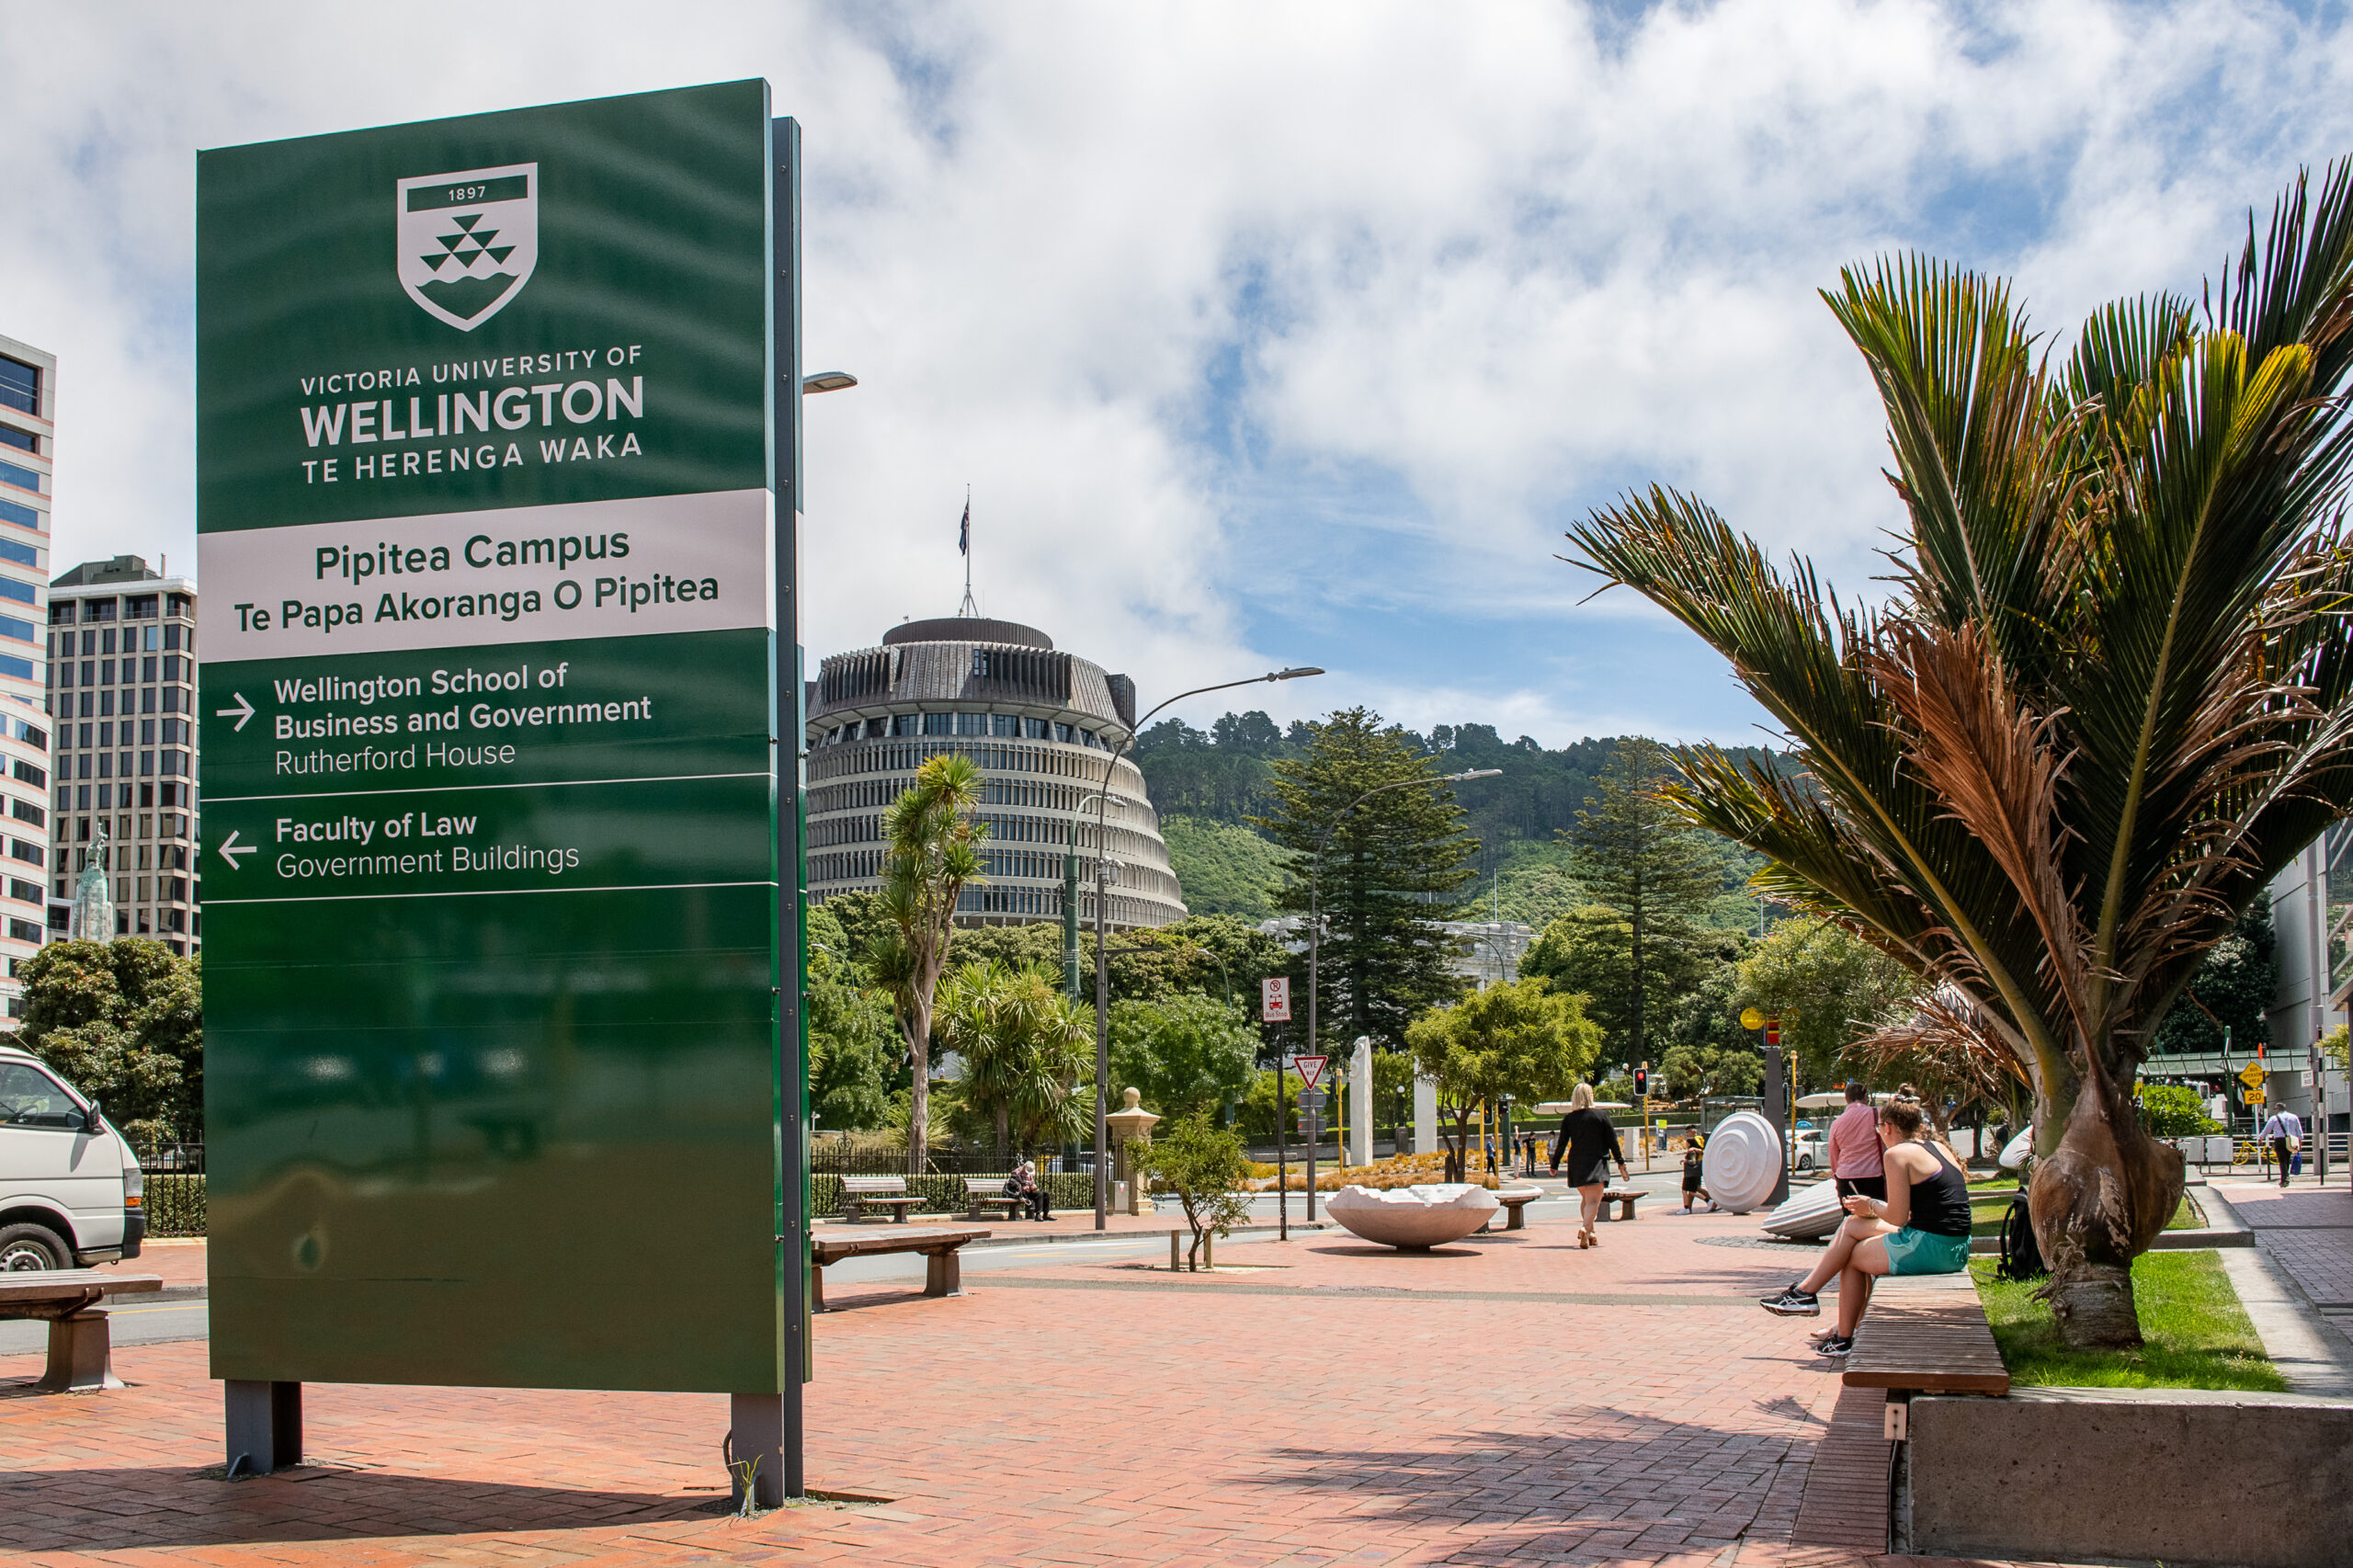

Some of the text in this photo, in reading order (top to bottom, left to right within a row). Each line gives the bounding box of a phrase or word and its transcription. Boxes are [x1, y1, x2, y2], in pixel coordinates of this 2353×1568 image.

[449, 186, 486, 201] 1897
[301, 345, 642, 396] VICTORIA UNIVERSITY OF
[300, 375, 643, 448] WELLINGTON
[301, 432, 642, 484] TE HERENGA WAKA
[316, 532, 630, 586] Pipitea Campus
[233, 573, 719, 634] Te Papa Akoranga O Pipitea
[273, 662, 569, 706] Wellington School of
[276, 696, 652, 740] Business and Government
[276, 742, 516, 775] Rutherford House
[277, 812, 478, 846] Faculty of Law
[277, 844, 580, 879] Government Buildings
[1276, 1010, 1288, 1018] Stop
[1303, 1061, 1317, 1069] GIVE
[2248, 1093, 2261, 1101] 20
